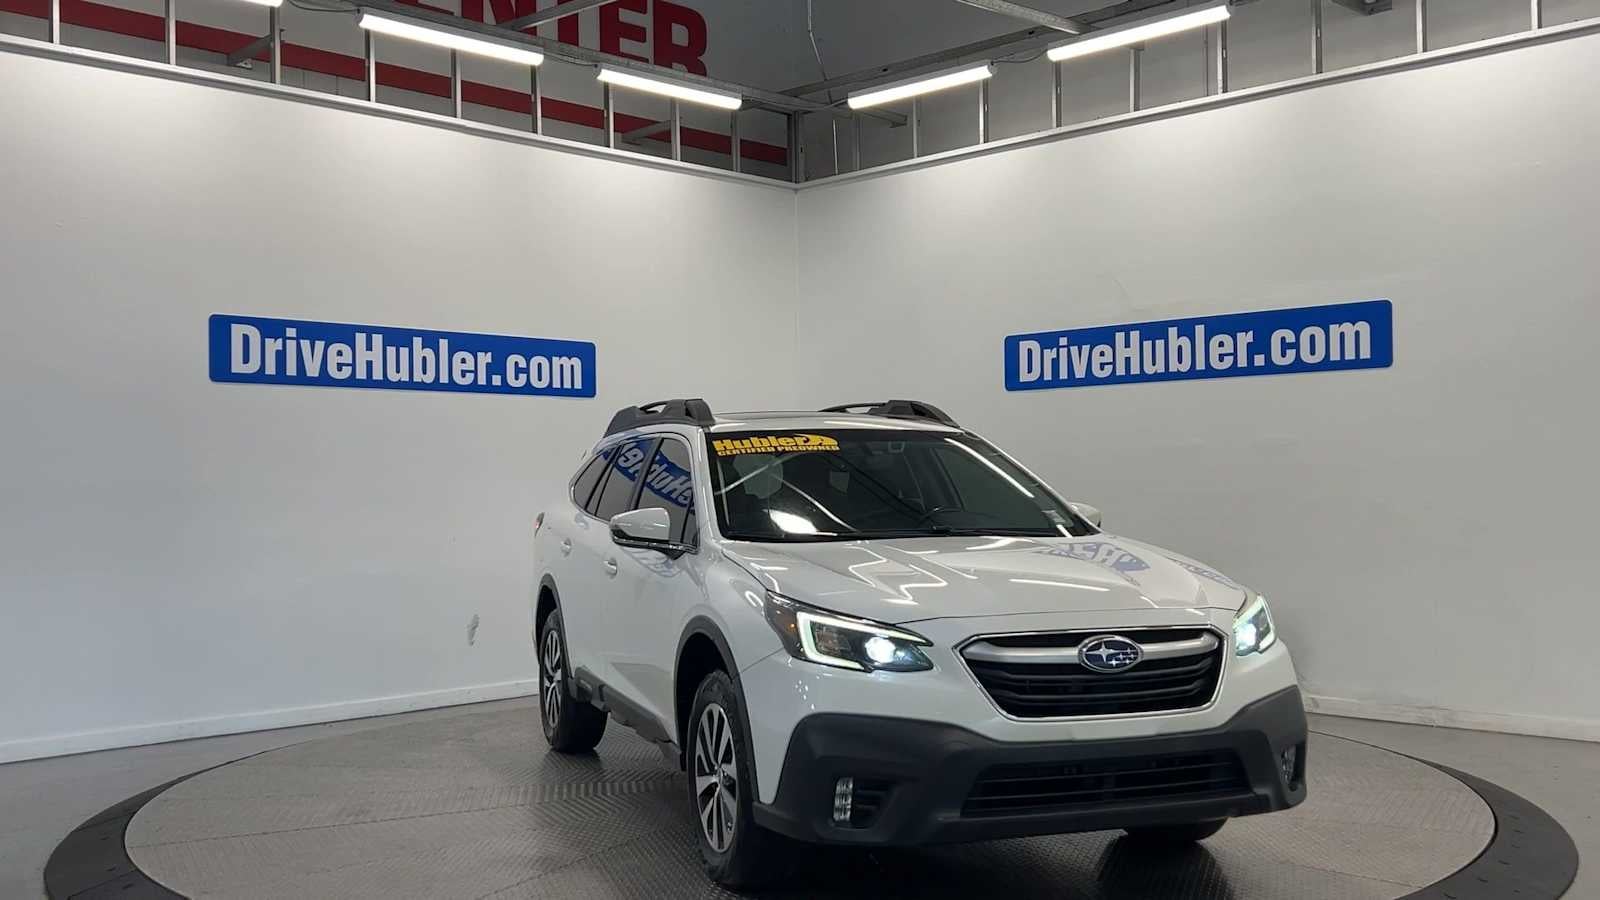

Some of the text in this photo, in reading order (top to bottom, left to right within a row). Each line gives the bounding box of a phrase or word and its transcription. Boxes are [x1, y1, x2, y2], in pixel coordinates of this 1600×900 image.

[230, 323, 583, 389] DriveHubler.com
[1018, 320, 1372, 383] DriveHubler.com
[712, 436, 808, 451] Hubler
[717, 446, 776, 456] CERTIFIED
